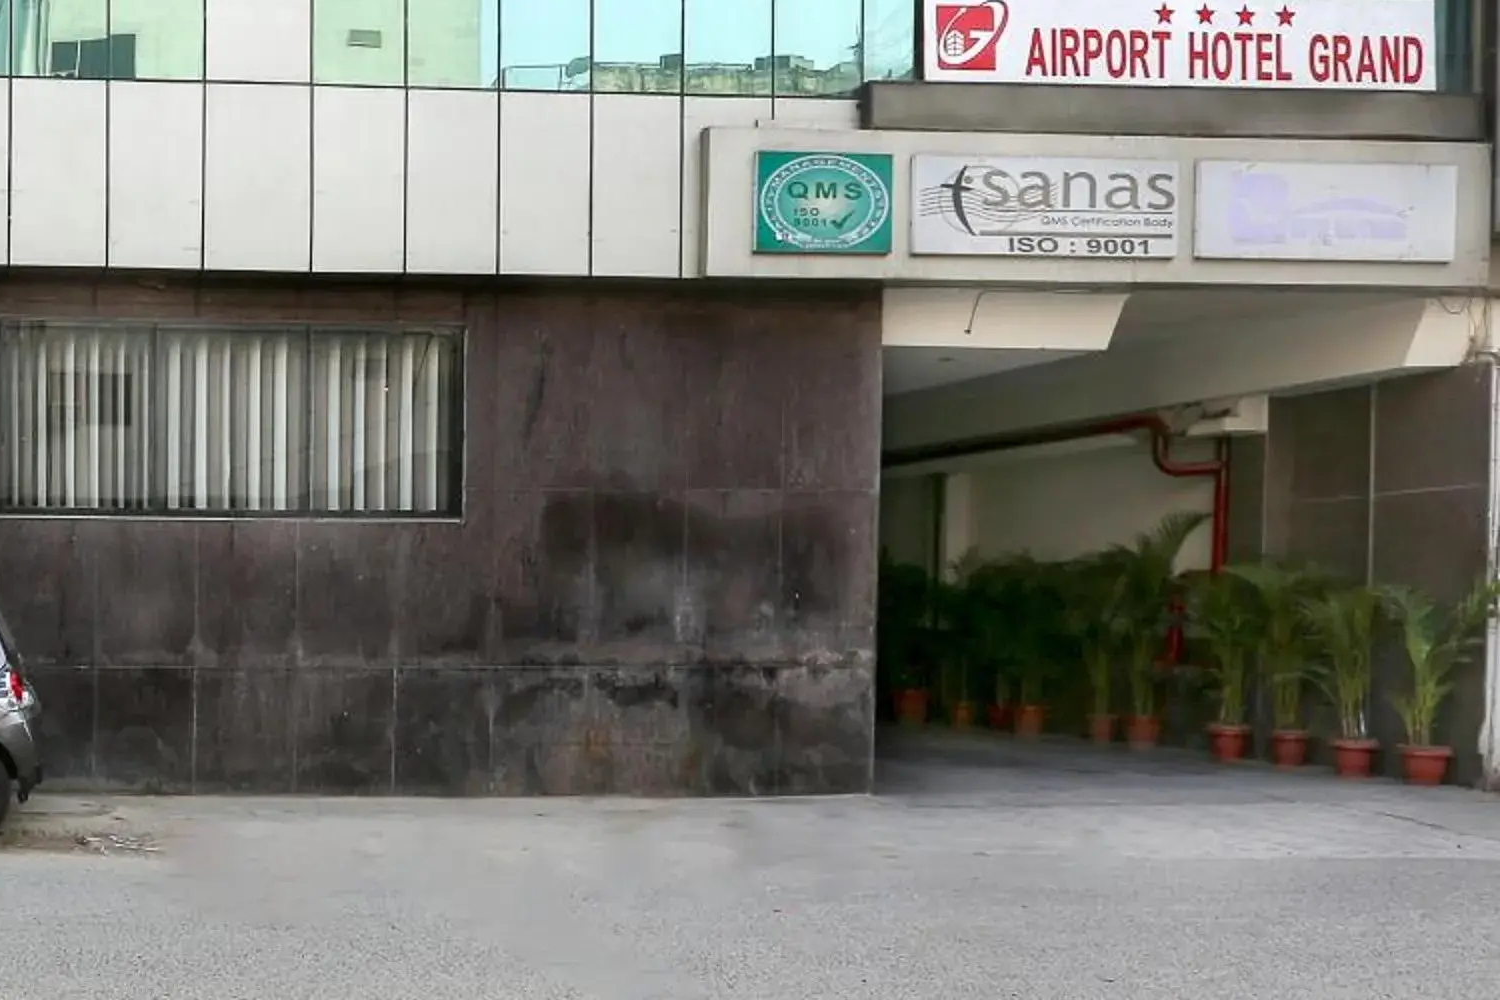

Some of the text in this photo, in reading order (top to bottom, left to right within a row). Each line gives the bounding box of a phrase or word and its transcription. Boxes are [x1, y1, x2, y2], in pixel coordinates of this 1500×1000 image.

[1025, 27, 1424, 84] AIRPORT HOTEL GRAND
[787, 181, 863, 200] QMS
[1143, 217, 1173, 228] Body
[1007, 237, 1059, 253] ISO
[1086, 239, 1150, 255] 9001
